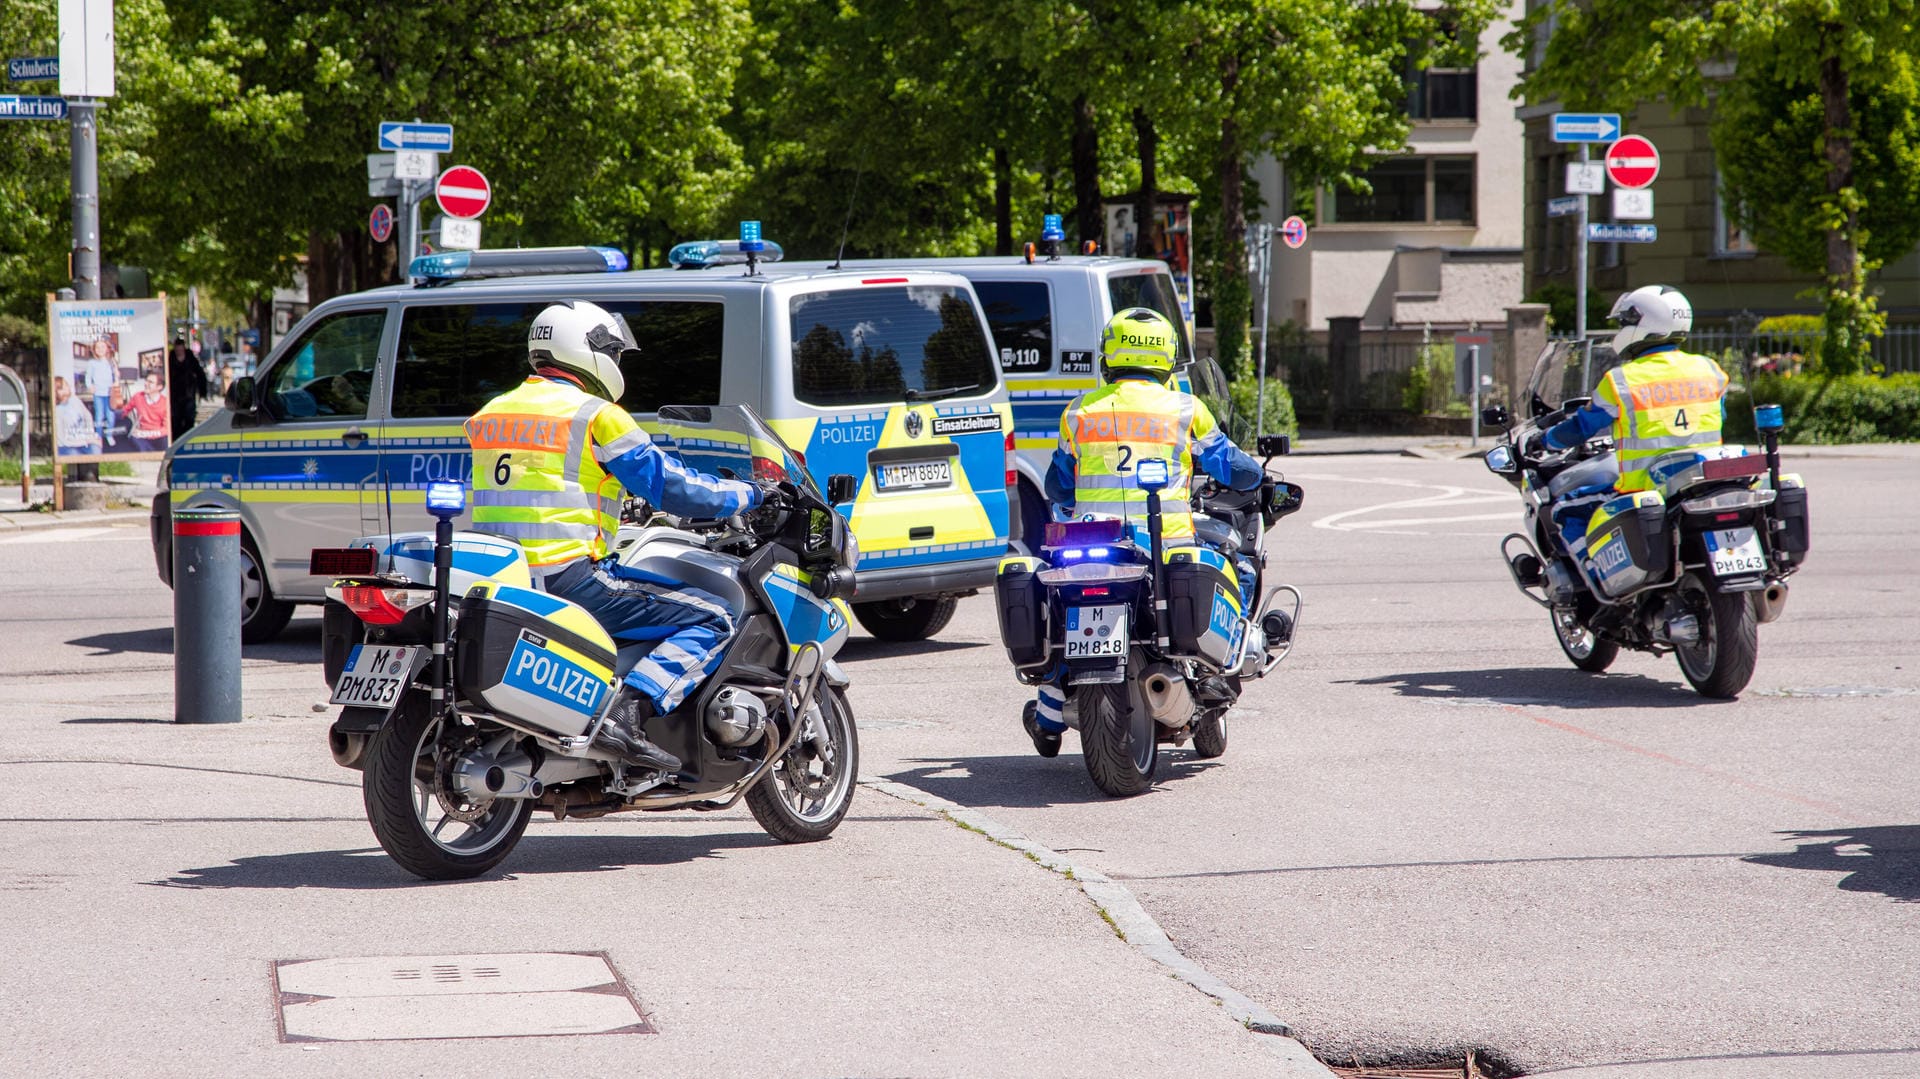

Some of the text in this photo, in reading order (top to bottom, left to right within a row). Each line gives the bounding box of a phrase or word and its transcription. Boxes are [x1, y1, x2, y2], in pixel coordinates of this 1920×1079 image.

[1121, 335, 1165, 346] POLIZEI
[1016, 348, 1040, 365] 110
[1062, 362, 1091, 372] M 7111
[1069, 352, 1084, 361] BY
[1640, 381, 1715, 404] POLIZEI
[934, 416, 1000, 433] Einsatzleitung
[1083, 415, 1169, 439] POLIZEI
[1674, 408, 1689, 430] 4
[475, 418, 558, 445] POLIZEI
[821, 425, 876, 444] POLIZEI
[1116, 445, 1132, 472] 2
[494, 453, 512, 486] 6
[885, 467, 894, 484] M
[919, 463, 948, 481] 8892
[1724, 531, 1736, 543] M
[1092, 607, 1103, 622] M
[370, 649, 391, 674] M
[515, 649, 601, 708] POLIZEI
